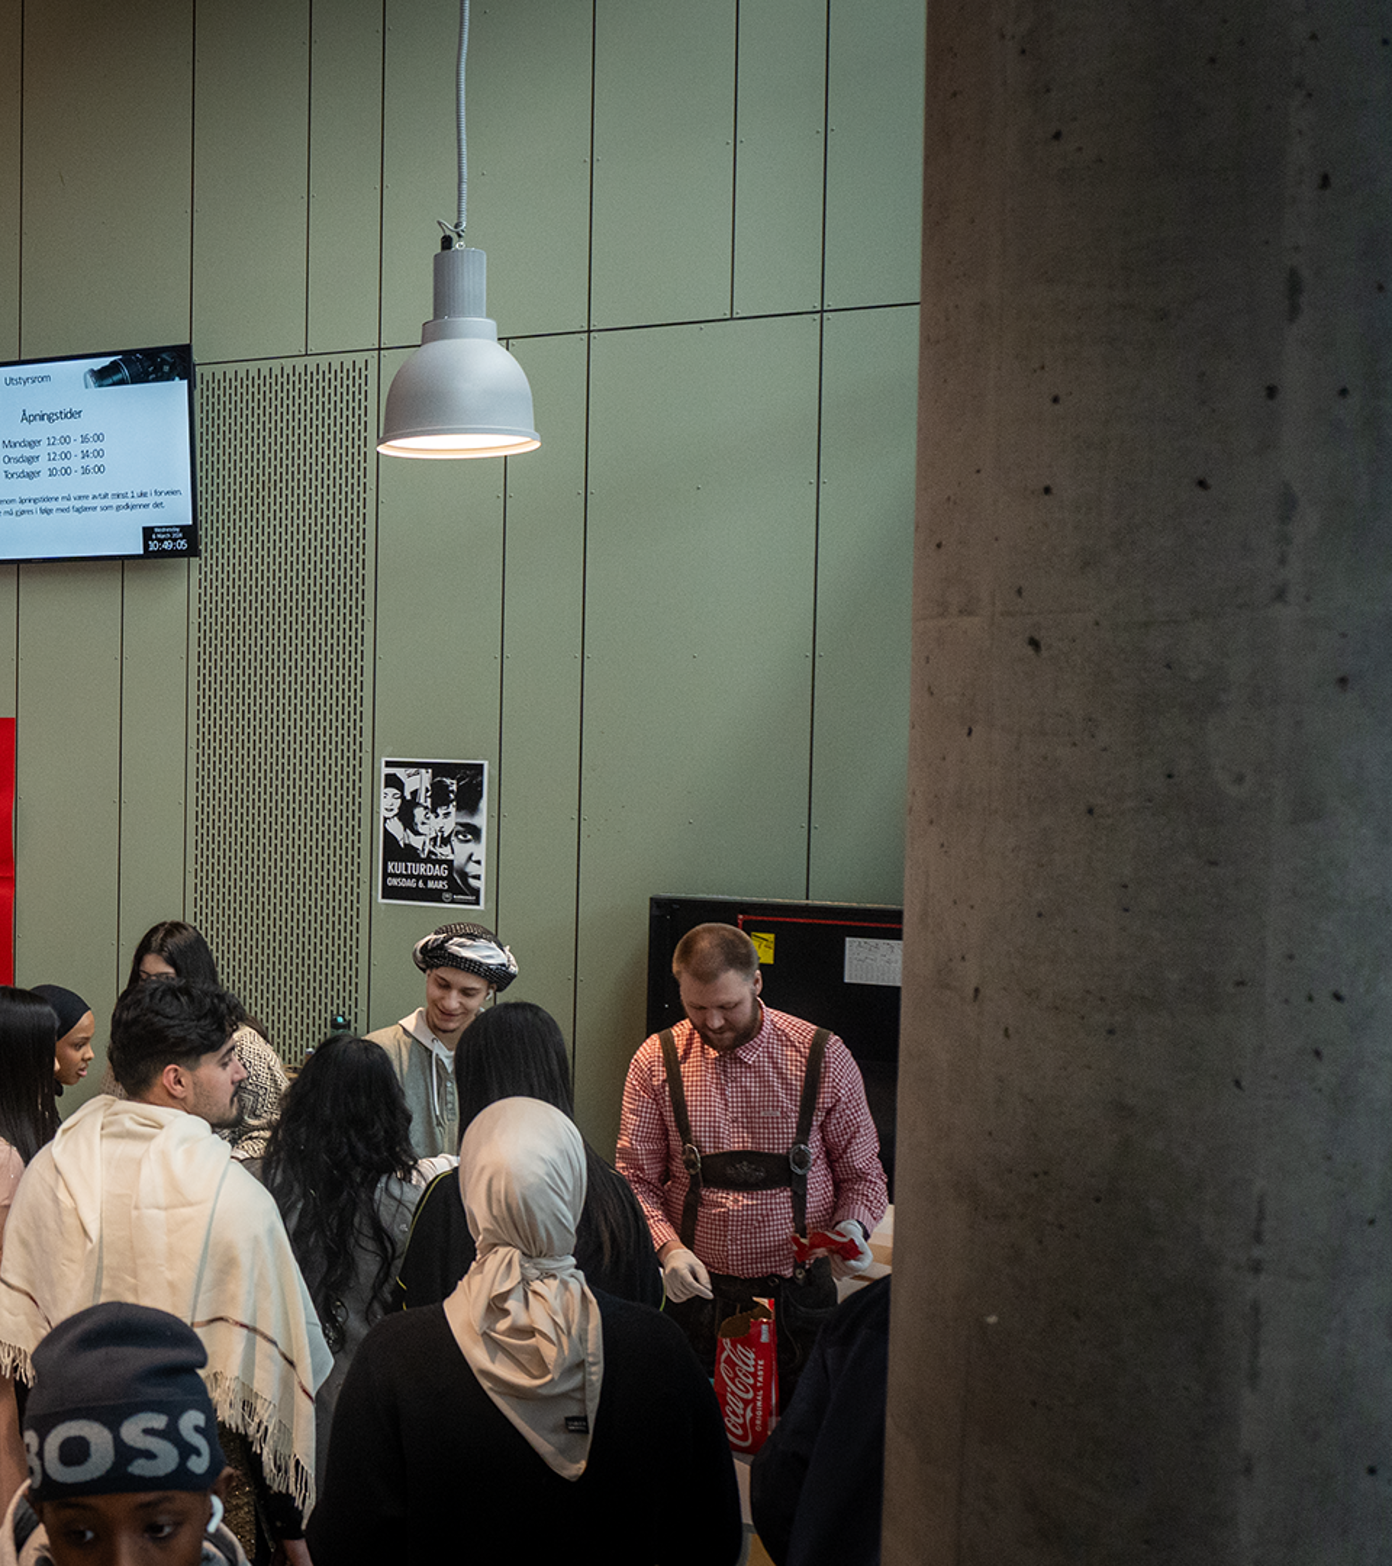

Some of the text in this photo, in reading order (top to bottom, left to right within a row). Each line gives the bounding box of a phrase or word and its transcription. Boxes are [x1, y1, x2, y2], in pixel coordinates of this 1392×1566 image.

[4, 374, 51, 386] Utstyrsrom
[20, 408, 82, 424] Åpningstider
[2, 438, 42, 449] Mandager
[46, 435, 71, 446] 12:00
[80, 432, 105, 444] 16:00
[2, 453, 40, 465] Onsdager
[47, 451, 71, 462] 12:00
[80, 448, 105, 460] 14:00
[3, 469, 41, 480] Torsdager
[48, 466, 72, 477] 10:00
[80, 464, 105, 475] 16:00
[148, 538, 188, 551] 10:49:05
[387, 861, 449, 877] KULTURDAG
[386, 877, 449, 890] ONSDAG 6. MARS
[755, 1359, 765, 1431] ORIGINAL TASTE
[24, 1409, 211, 1489] BOSS
